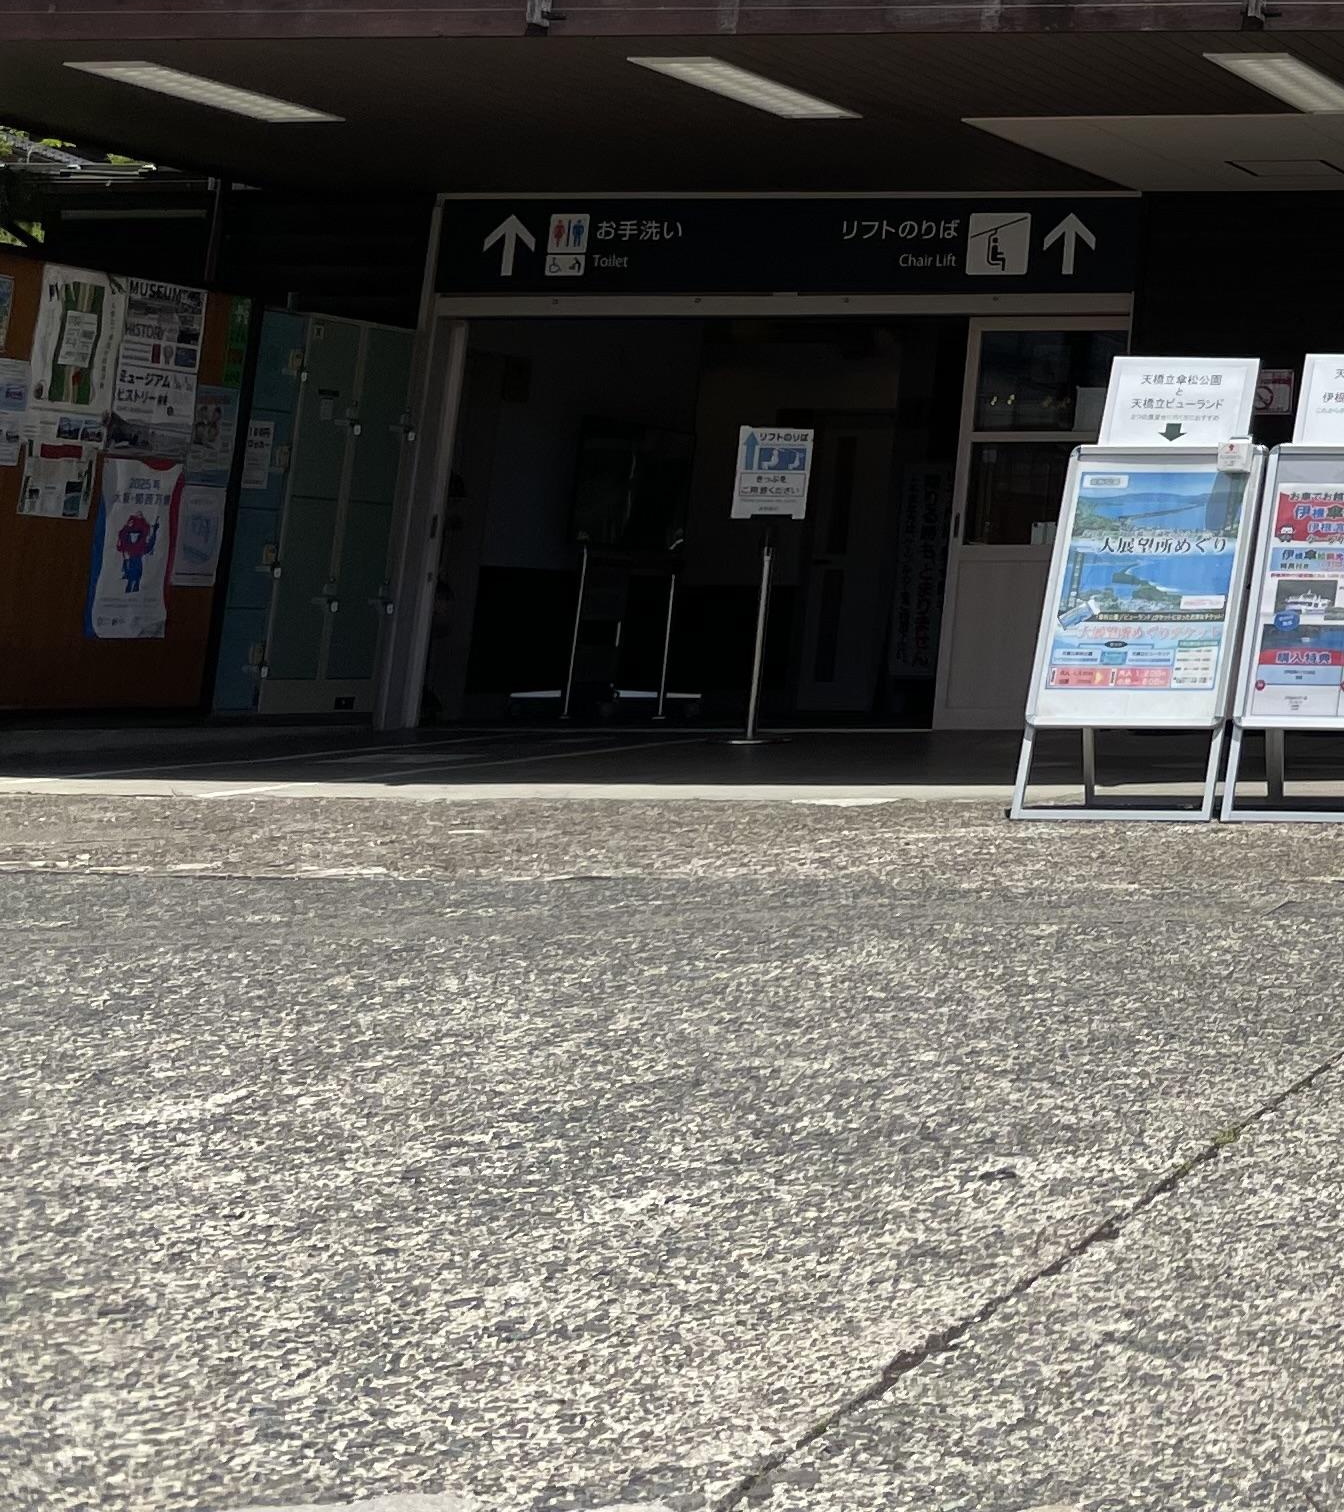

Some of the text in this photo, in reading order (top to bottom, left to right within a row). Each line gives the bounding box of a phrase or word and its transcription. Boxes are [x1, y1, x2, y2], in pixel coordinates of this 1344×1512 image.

[596, 219, 683, 241] お手洗い
[842, 219, 961, 240] リフトのりば
[592, 254, 629, 268] Toilet
[899, 253, 957, 267] Chair Lift
[129, 279, 182, 302] MUSEUM
[119, 369, 171, 389] ミュージアム
[1141, 374, 1223, 386] 天橋立傘松公園
[1130, 398, 1225, 410] 天橋立ビューランド
[759, 432, 810, 442] リフトのりば
